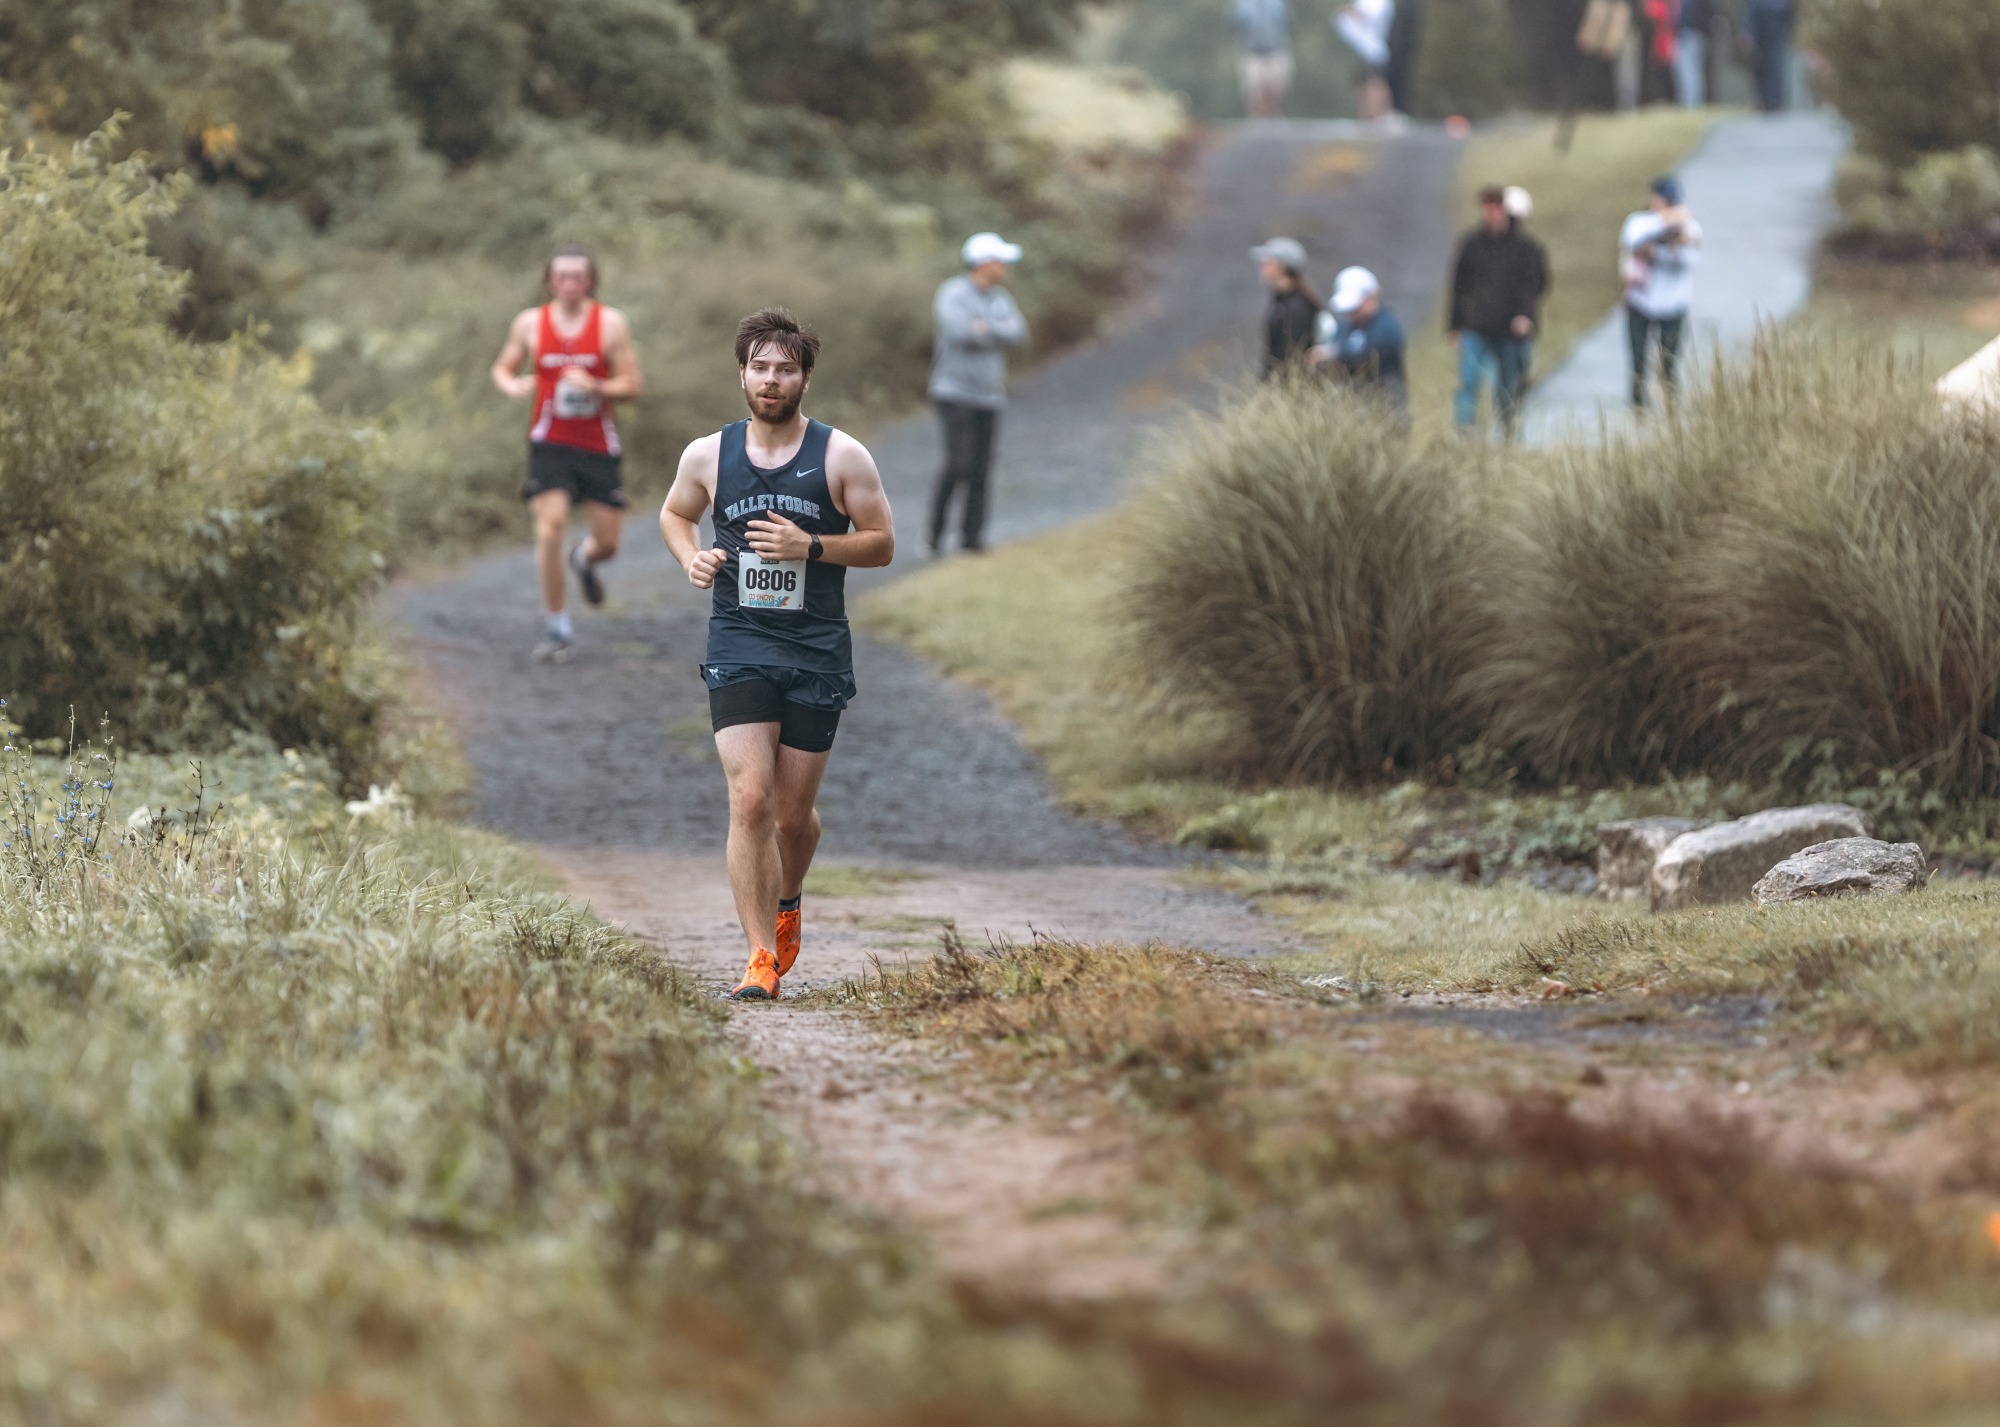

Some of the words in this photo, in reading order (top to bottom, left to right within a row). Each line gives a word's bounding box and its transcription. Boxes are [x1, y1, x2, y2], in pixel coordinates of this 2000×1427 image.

[725, 494, 775, 521] VALLEY
[777, 494, 820, 520] FORGE
[746, 568, 796, 591] 0806
